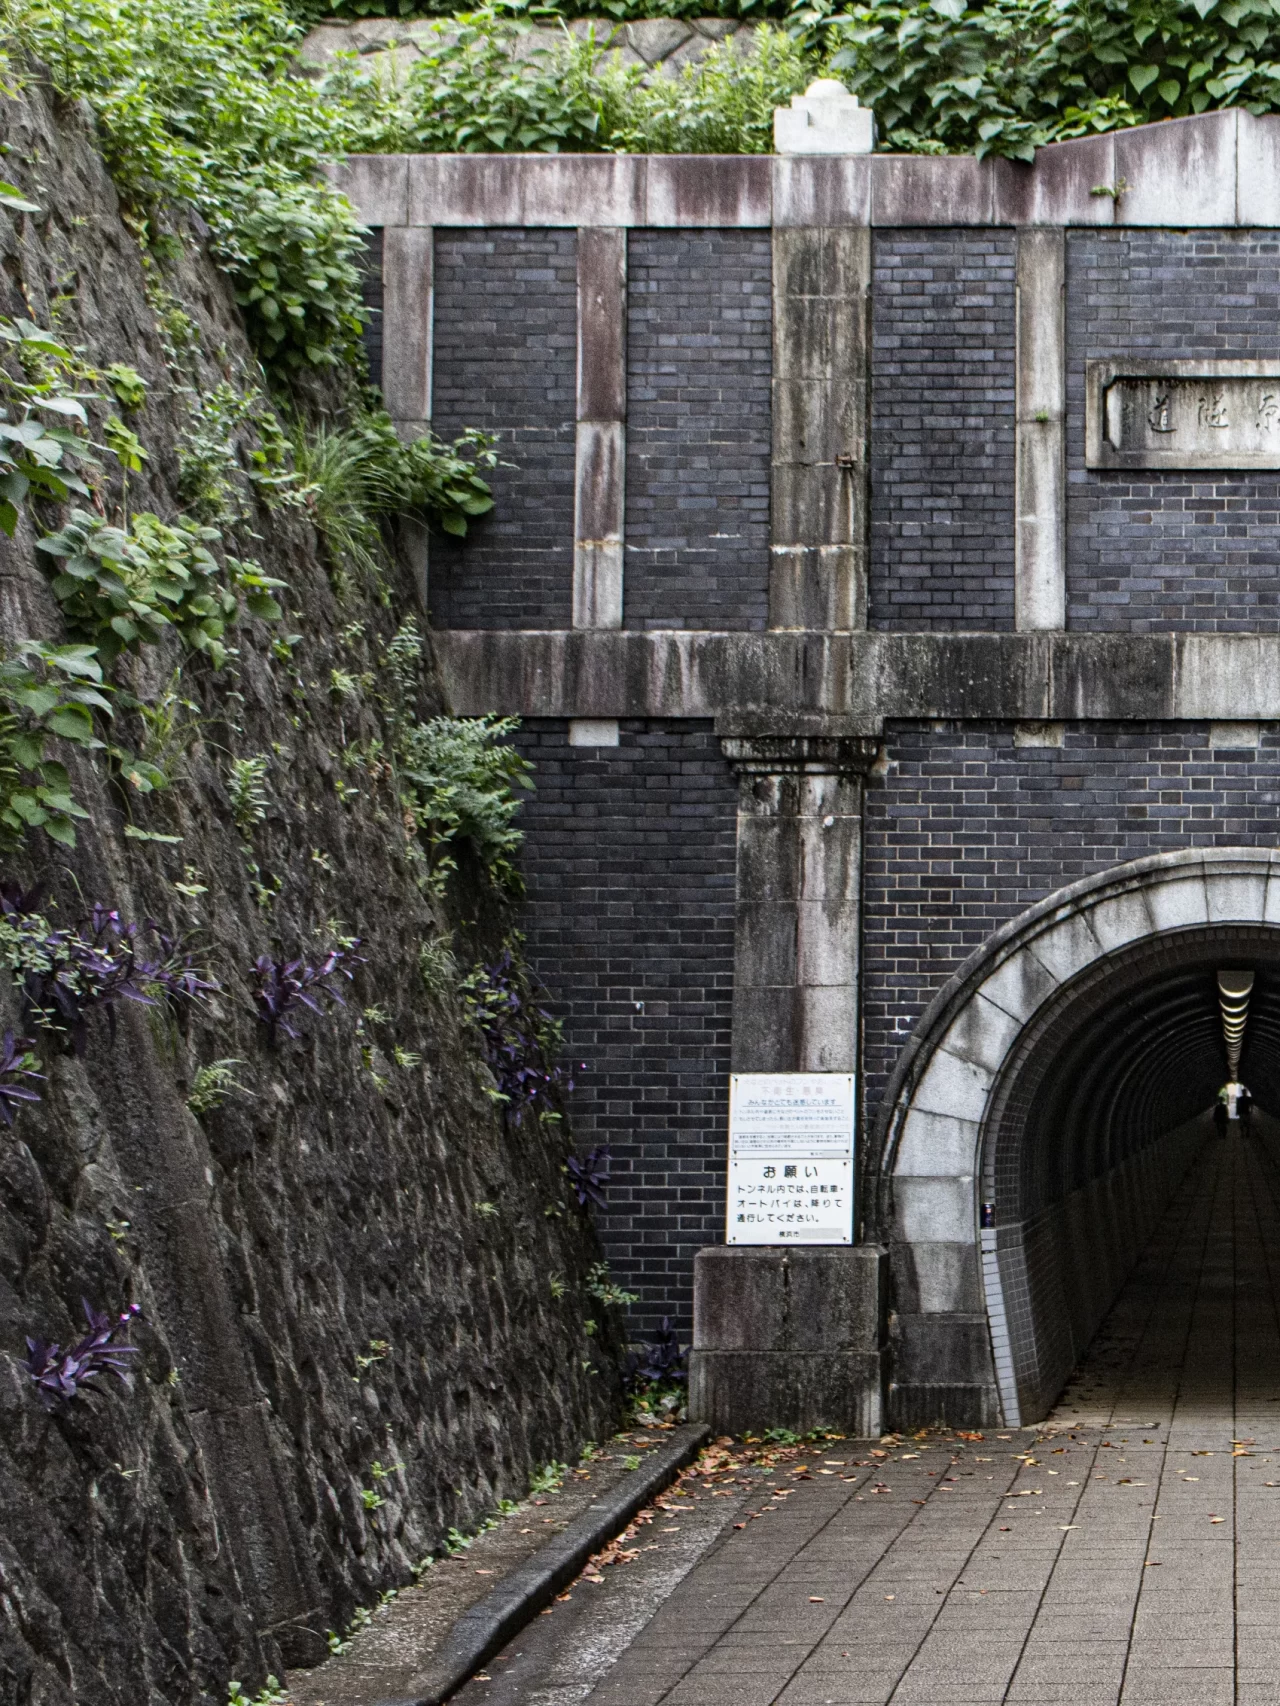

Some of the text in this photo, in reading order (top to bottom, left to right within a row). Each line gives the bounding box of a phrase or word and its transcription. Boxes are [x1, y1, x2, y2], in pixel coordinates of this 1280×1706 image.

[763, 1165, 819, 1179] お願い
[737, 1213, 820, 1223] 通行してください。
